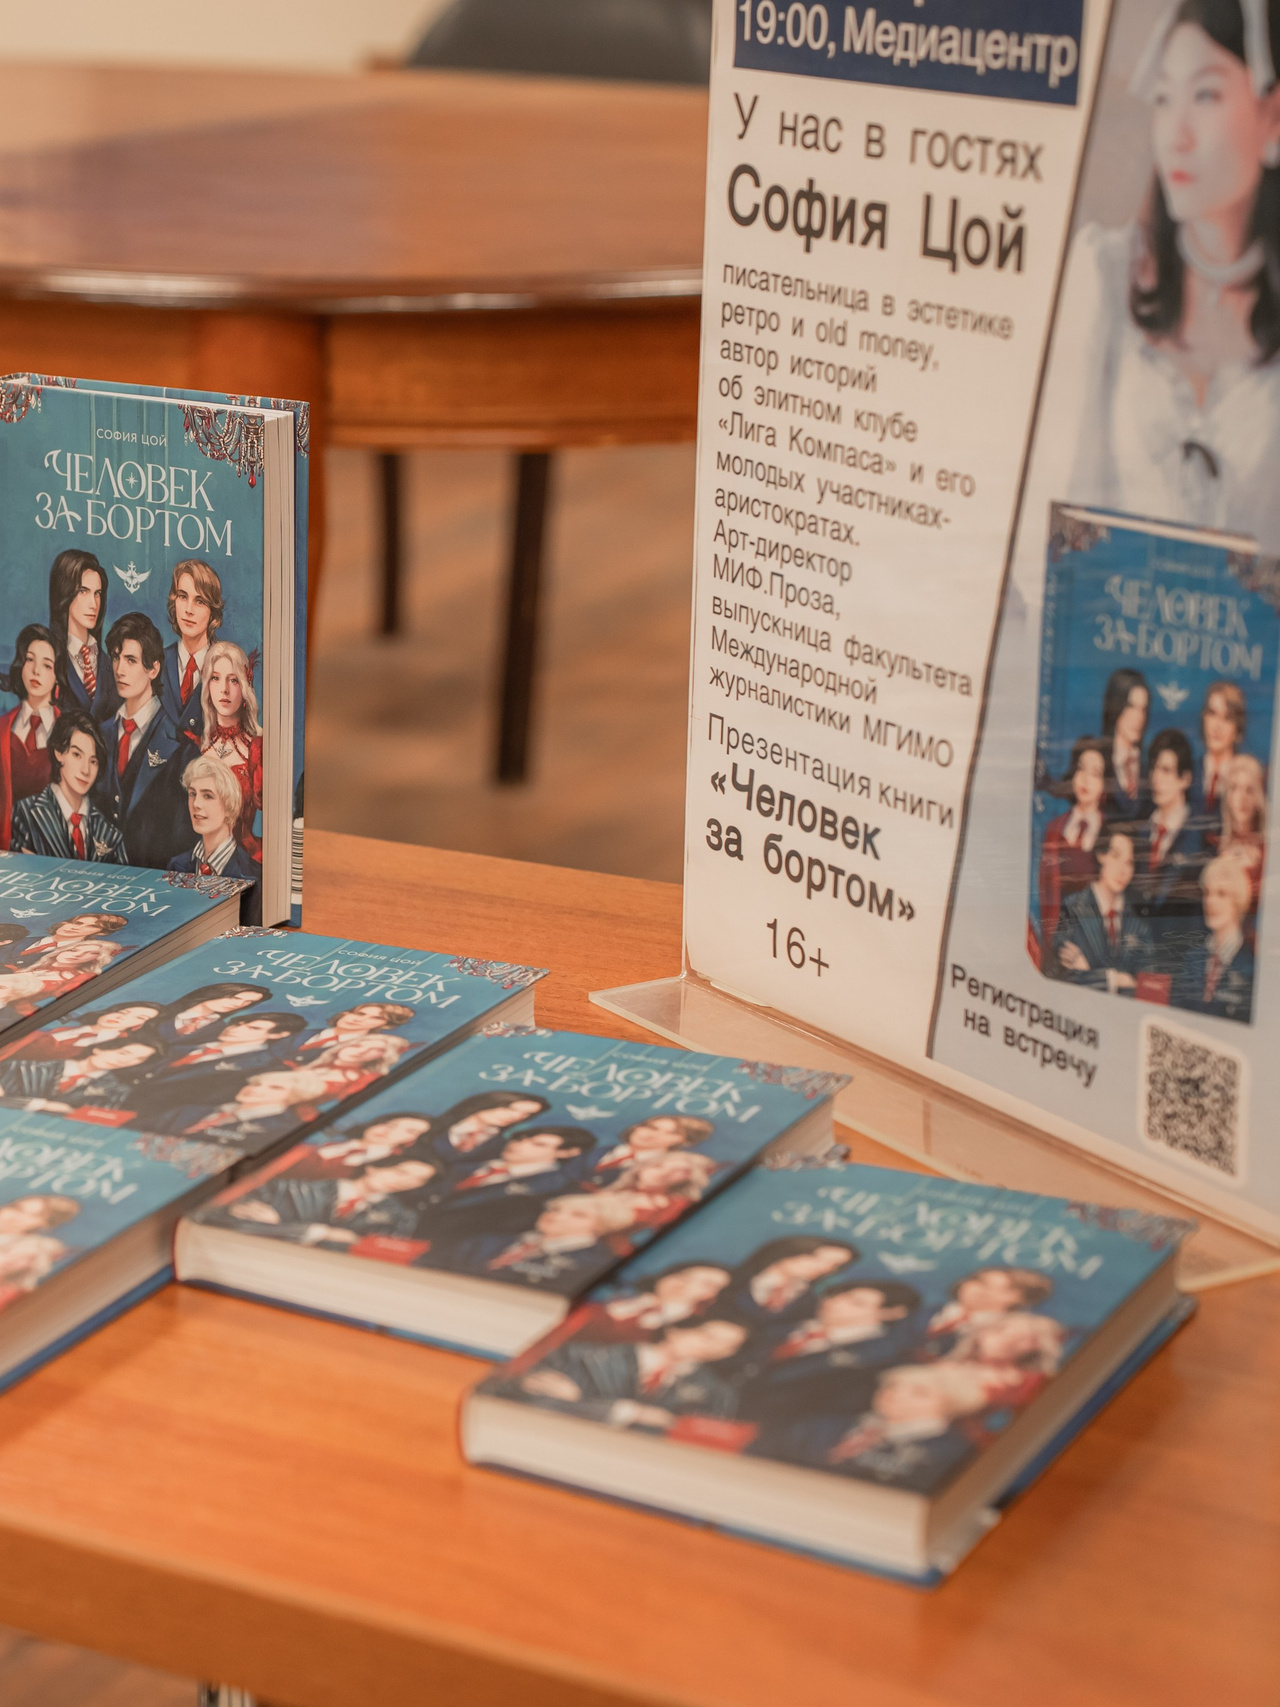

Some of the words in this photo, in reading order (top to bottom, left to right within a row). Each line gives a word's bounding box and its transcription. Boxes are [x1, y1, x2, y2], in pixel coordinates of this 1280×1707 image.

[738, 1, 836, 58] 19:00,
[842, 8, 1078, 88] Медиацентр
[733, 92, 759, 140] У
[778, 110, 844, 153] нас
[865, 123, 887, 159] в
[910, 127, 1046, 183] гостях
[727, 163, 888, 253] София
[922, 193, 1026, 273] Цой
[721, 302, 781, 337] ретро
[792, 313, 805, 337] и
[816, 317, 847, 347] old
[859, 330, 940, 372] money,
[722, 263, 869, 315] писательница
[882, 294, 896, 316] в
[907, 300, 1014, 340] эстетике
[720, 338, 780, 376] автор
[790, 352, 878, 394] историй
[96, 428, 138, 444] СОФИЯ
[141, 434, 168, 448] ЦОЙ
[719, 374, 743, 400] об
[754, 384, 842, 424] элитном
[854, 407, 918, 442] клубе
[43, 449, 216, 513] ЧЕЛОВЕК
[716, 450, 805, 493] молодых
[817, 477, 951, 531] участниках-
[718, 412, 777, 447] «Лига
[789, 426, 897, 476] Компаса»
[910, 461, 923, 483] и
[936, 468, 976, 498] его
[34, 492, 83, 533] ЗА
[86, 499, 233, 557] БОРТОМ
[713, 519, 853, 587] Арт-директор
[715, 487, 860, 547] аристократах.
[713, 553, 841, 620] МИФ.Проза,
[711, 625, 878, 705] Международной
[712, 595, 832, 652] выпускница
[844, 635, 973, 697] факультета
[709, 665, 851, 734] журналистики
[862, 714, 954, 769] МГИМО
[708, 712, 871, 799] Презентация
[878, 783, 955, 830] книги
[710, 761, 882, 861] «Человек
[706, 817, 744, 862] за
[763, 832, 916, 923] бортом»
[213, 960, 273, 981] ЗА
[271, 969, 462, 1009] БОРТОМ
[256, 949, 462, 993] ЧЕЛОВЕК
[766, 918, 830, 978] 16+
[950, 964, 1100, 1050] Регистрация
[963, 1009, 991, 1038] на
[1004, 1025, 1099, 1088] встречу
